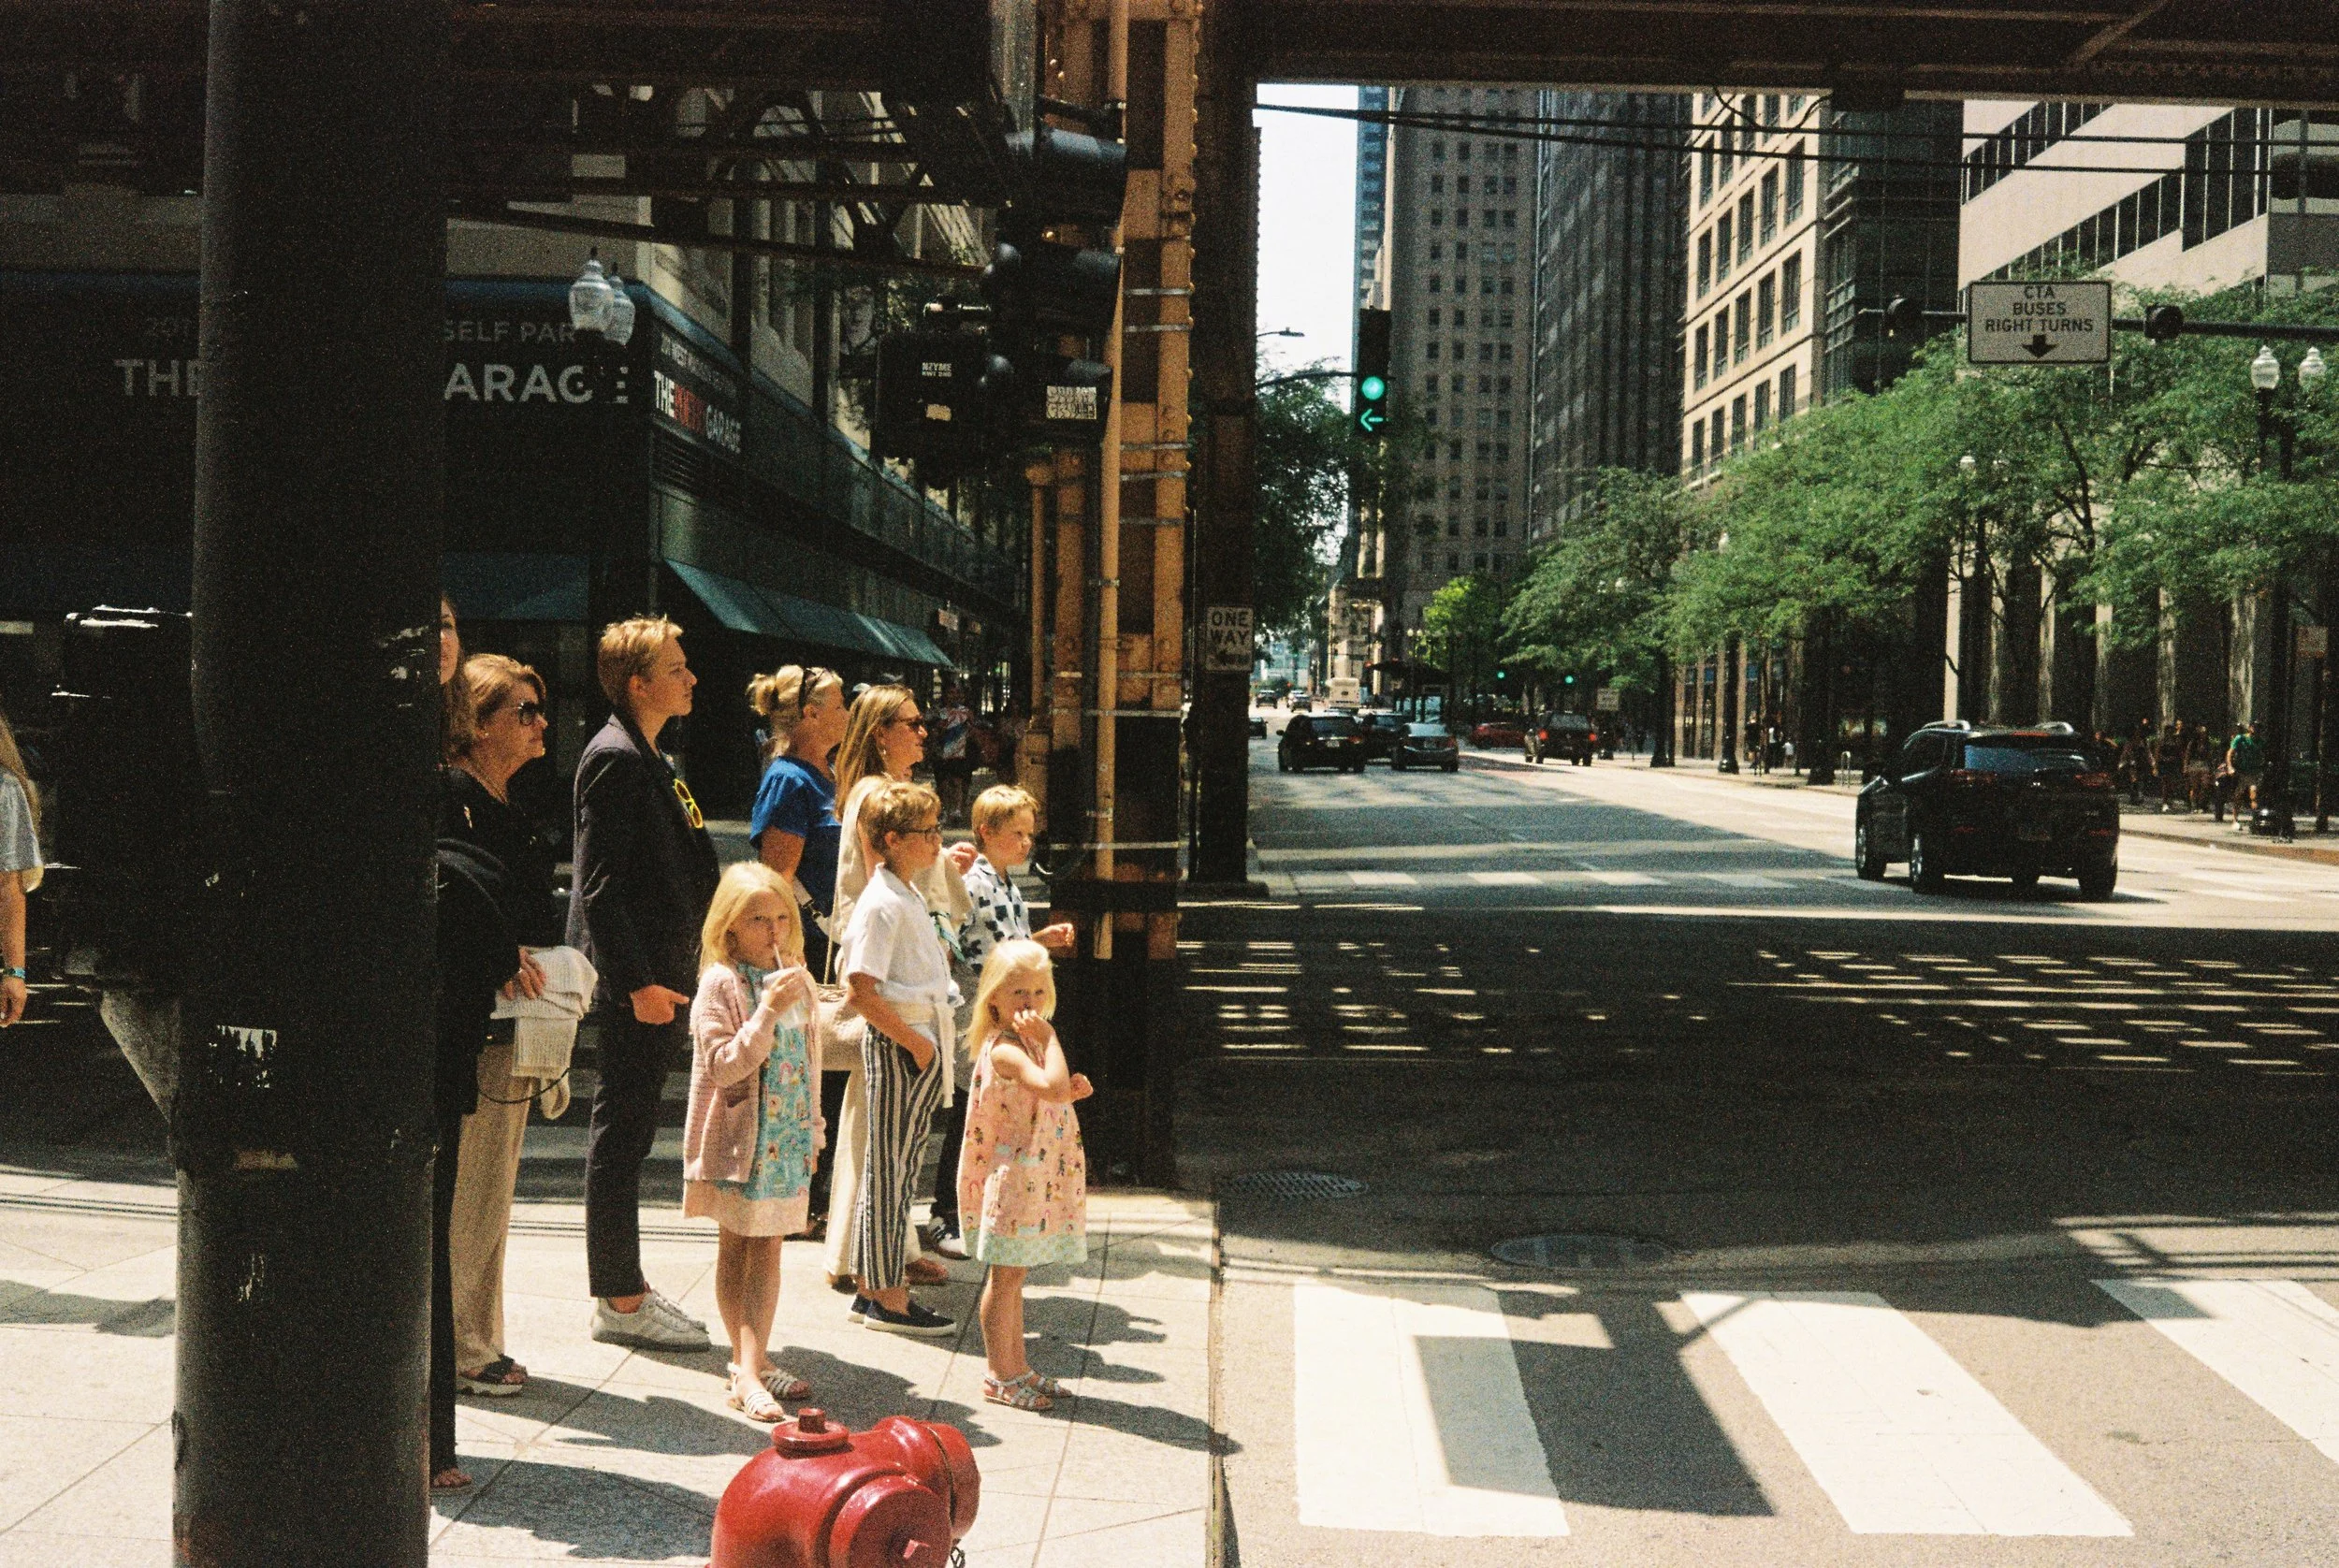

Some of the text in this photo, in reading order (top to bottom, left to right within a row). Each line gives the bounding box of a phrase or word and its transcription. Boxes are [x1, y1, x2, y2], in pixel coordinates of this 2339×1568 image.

[2024, 286, 2055, 298] CTA
[2012, 302, 2067, 315] BUSES
[444, 320, 577, 343] SELF PAR
[1984, 318, 2093, 332] RIGHT TURNS
[113, 358, 203, 397] THE
[443, 362, 629, 404] ARAG
[654, 370, 675, 418] THE
[1212, 611, 1249, 627] ONE
[1210, 629, 1250, 645] WAY
